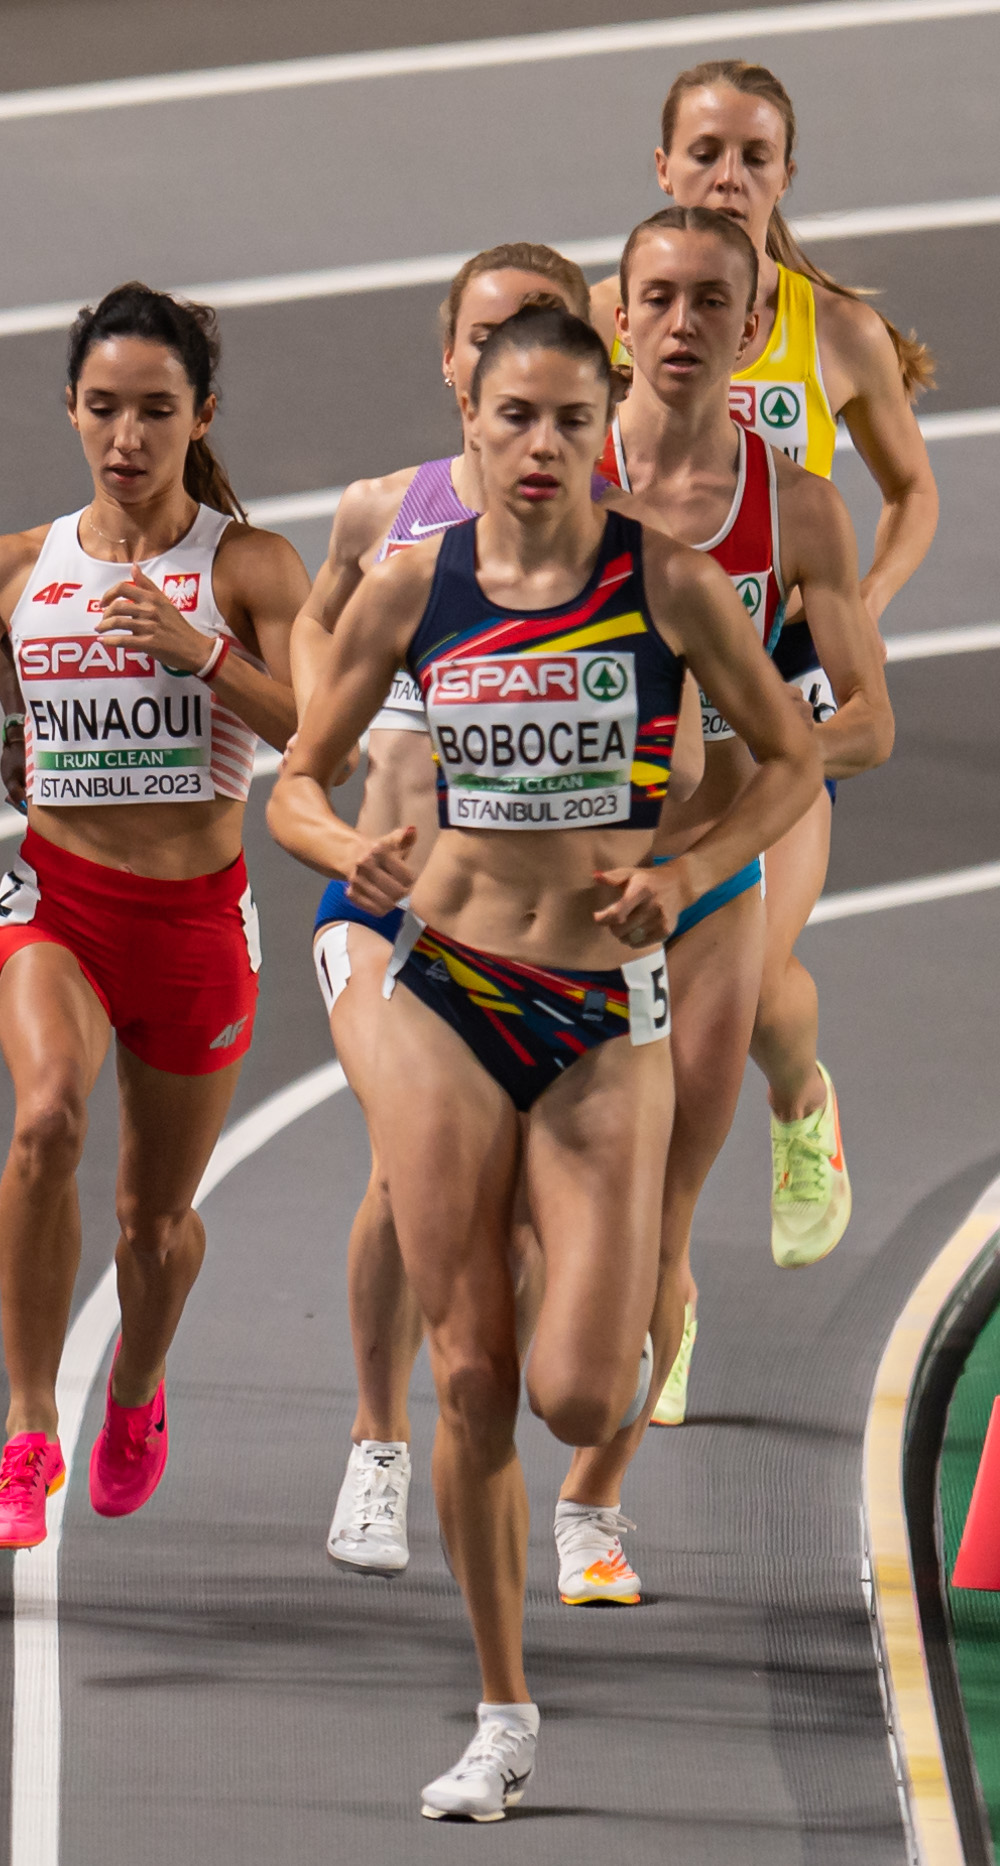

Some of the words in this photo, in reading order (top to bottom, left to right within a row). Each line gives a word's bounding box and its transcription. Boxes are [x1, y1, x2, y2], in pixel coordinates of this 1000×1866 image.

[21, 641, 151, 675] SPAR
[437, 662, 576, 699] SPAR
[29, 694, 203, 742] ENNAOUI
[63, 753, 100, 768] RUN
[436, 720, 626, 767] BOBOCEA
[41, 776, 140, 798] ISTANBUL
[144, 774, 202, 796] 2023
[525, 775, 584, 792] CLEAN
[457, 797, 560, 822] ISTANBUL
[564, 795, 618, 820] 2023
[650, 966, 668, 1029] 5
